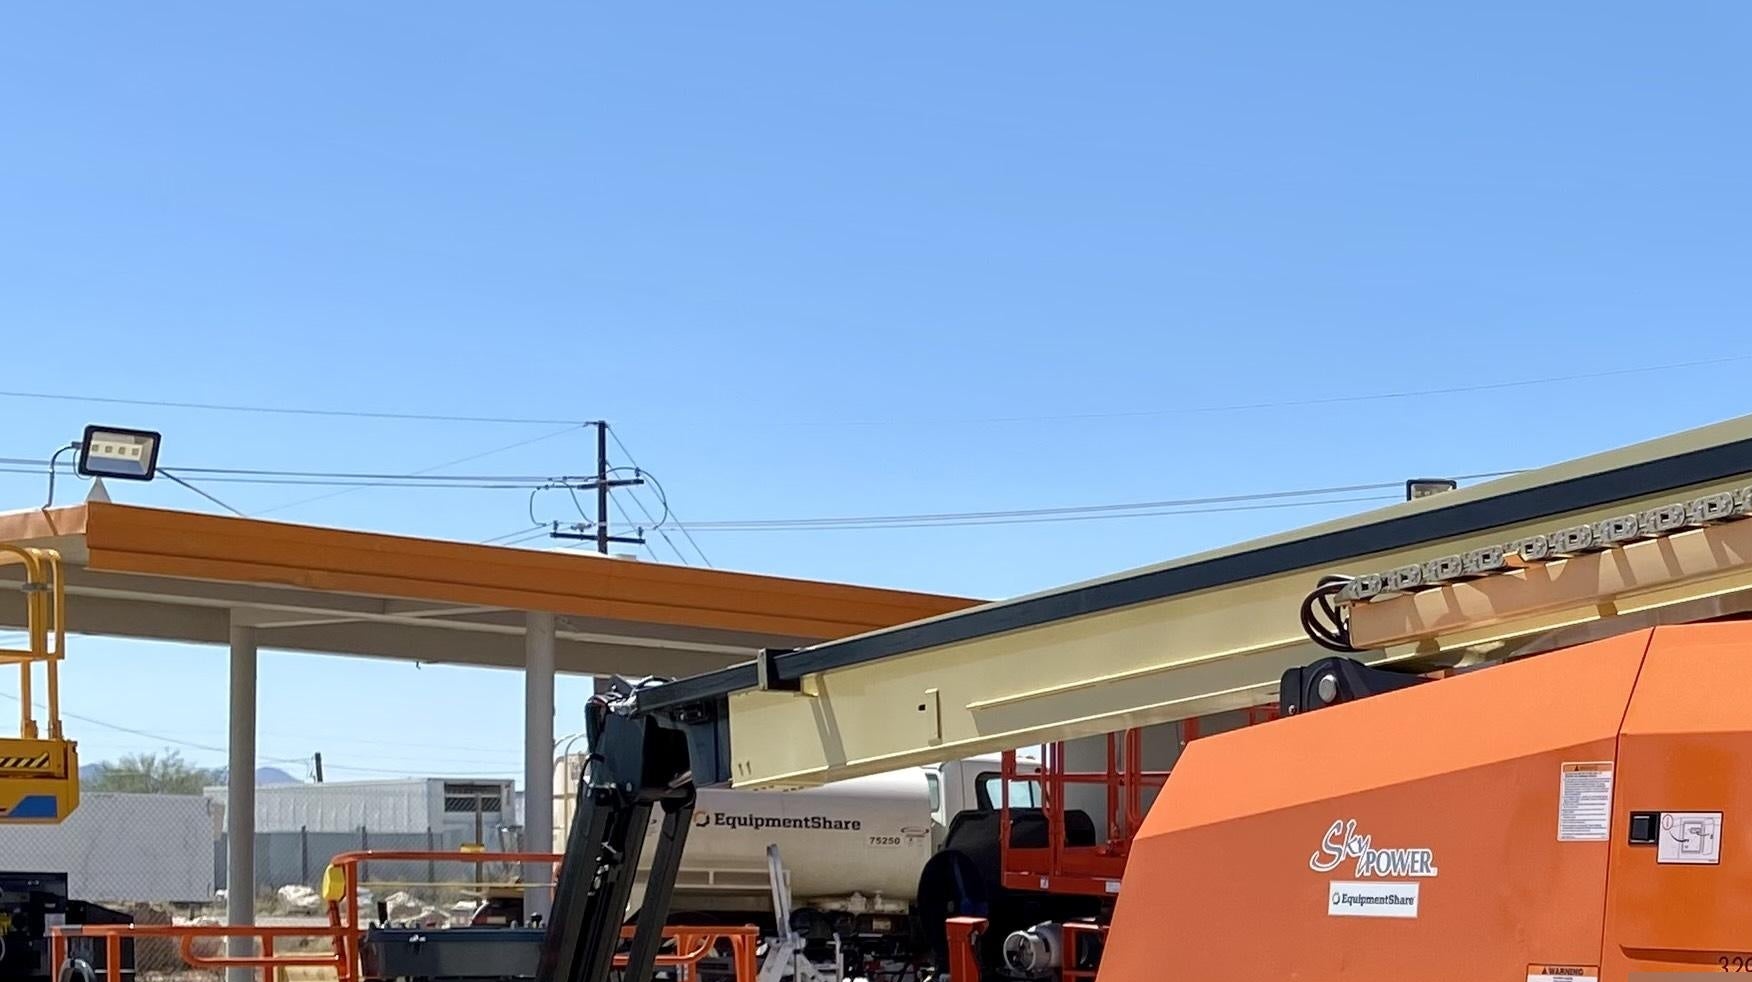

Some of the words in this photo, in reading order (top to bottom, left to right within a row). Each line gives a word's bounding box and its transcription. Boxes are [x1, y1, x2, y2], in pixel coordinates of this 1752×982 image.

[714, 812, 861, 831] EquipmentShare
[869, 836, 900, 845] 75250
[1342, 893, 1415, 907] EquipmentShare
